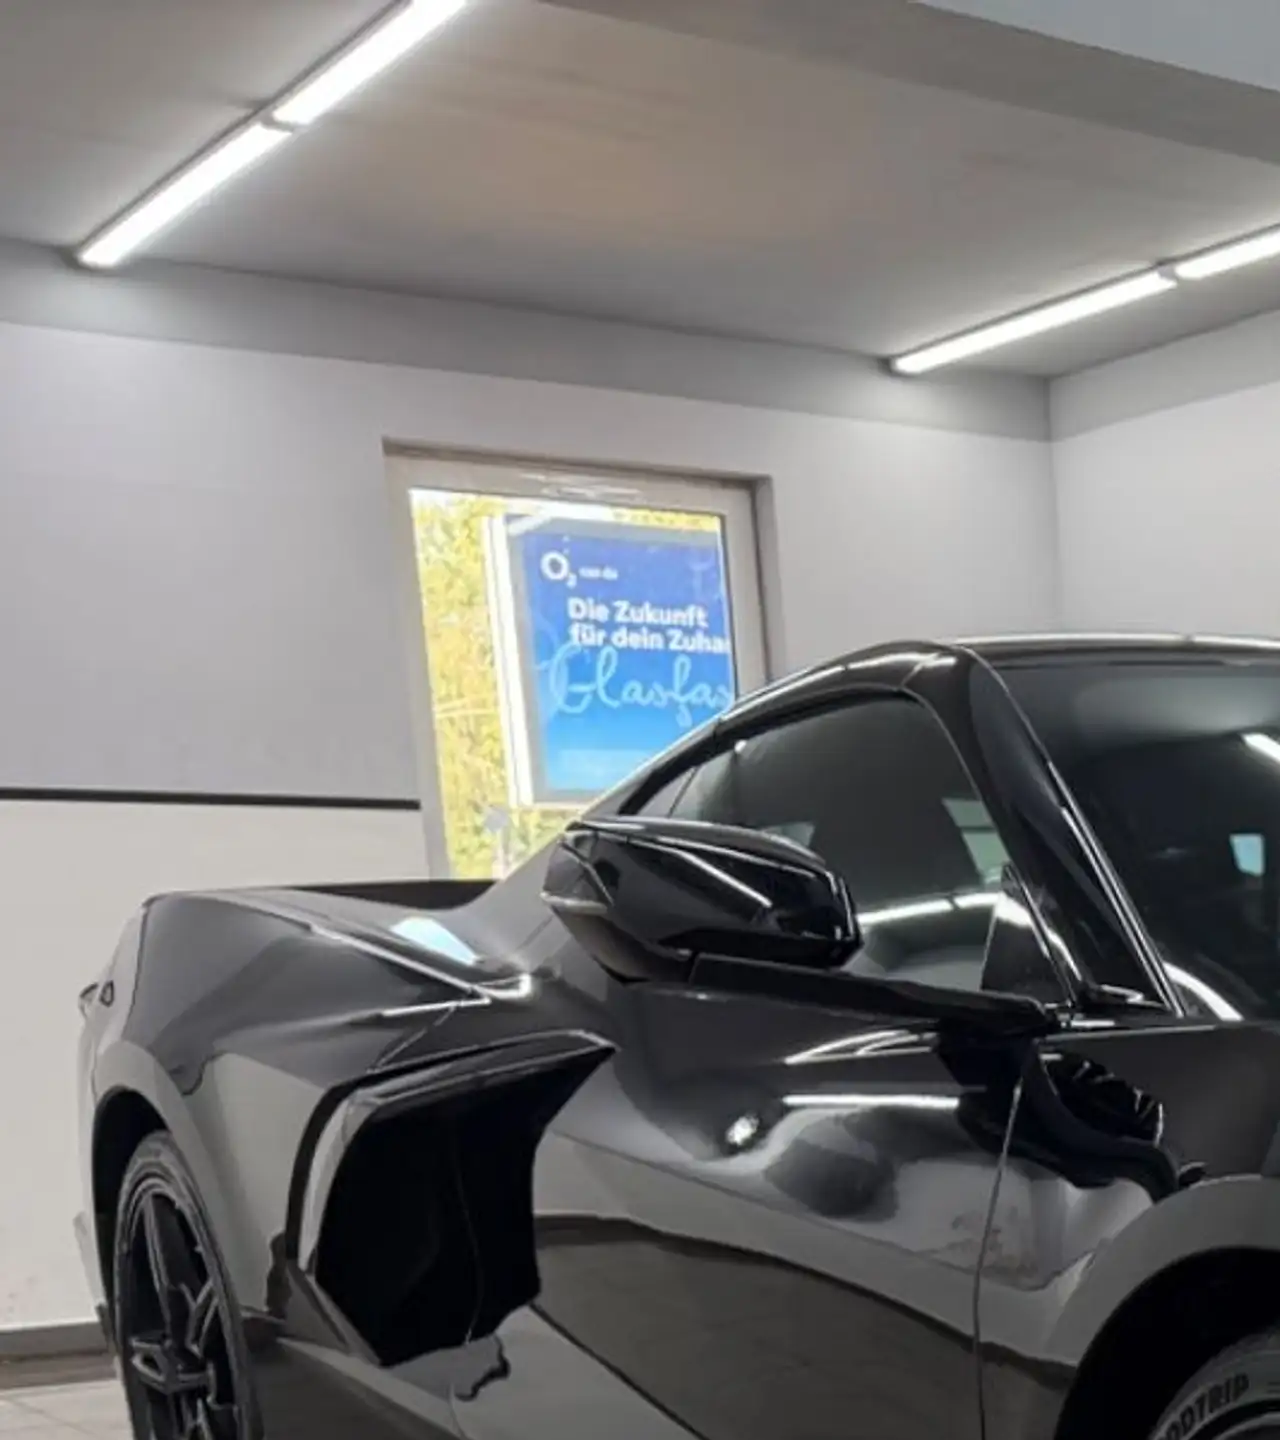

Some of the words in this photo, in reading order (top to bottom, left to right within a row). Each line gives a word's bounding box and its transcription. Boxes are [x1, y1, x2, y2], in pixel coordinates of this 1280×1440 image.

[568, 598, 609, 622] Die
[613, 601, 708, 628] Zukunft
[570, 622, 606, 646] für
[611, 626, 663, 650] dein
